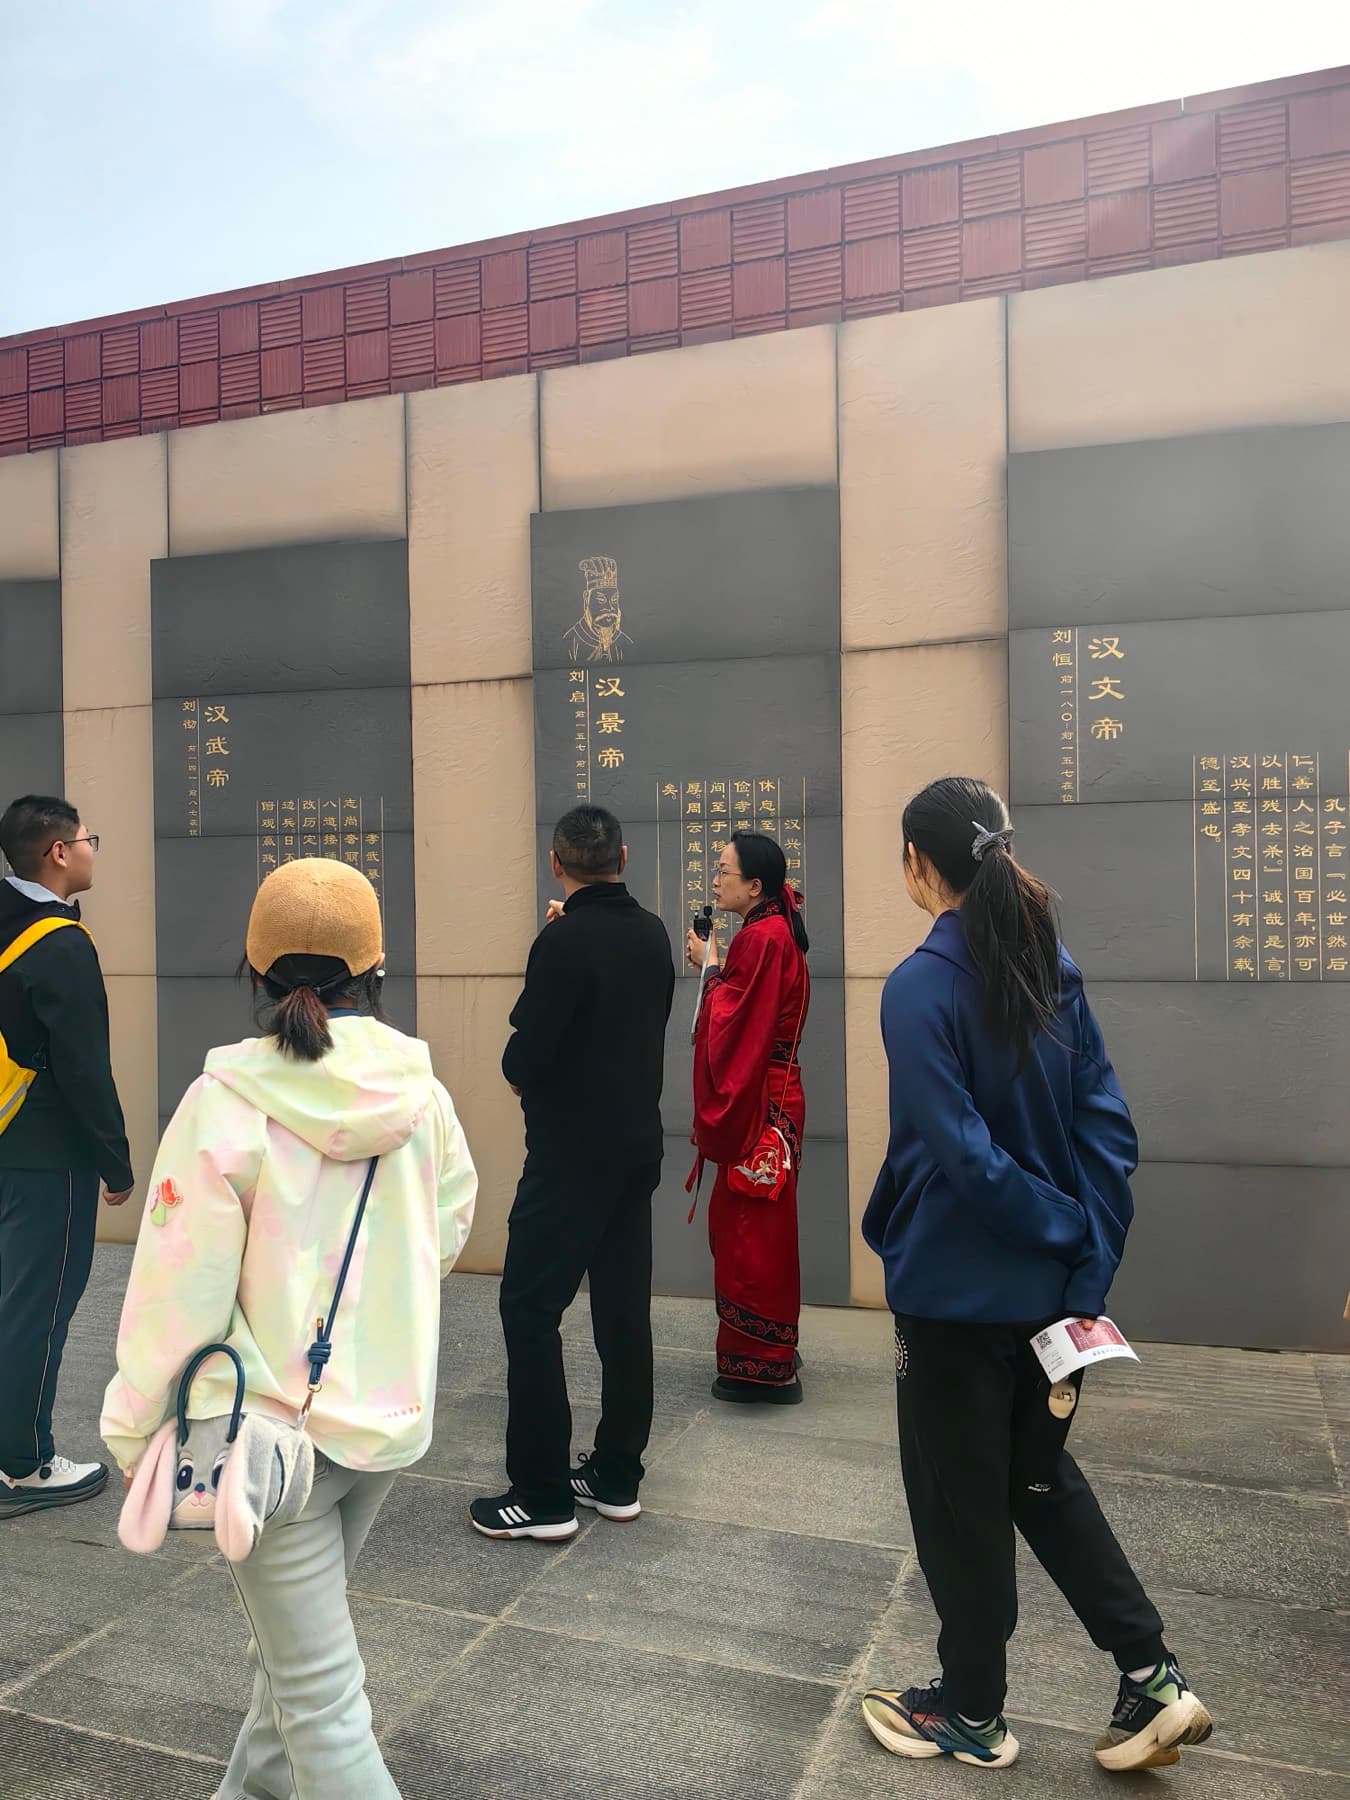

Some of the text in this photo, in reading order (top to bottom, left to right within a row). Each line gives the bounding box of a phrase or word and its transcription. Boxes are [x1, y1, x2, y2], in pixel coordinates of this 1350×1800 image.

[568, 669, 586, 703] 刘启
[1052, 629, 1073, 668] 刘恒
[1088, 637, 1125, 740] 汉文帝
[182, 699, 197, 730] 刘彻
[204, 705, 231, 788] 汉武帝
[595, 677, 626, 769] 汉景帝
[783, 818, 802, 909] 汉兴,扫除
